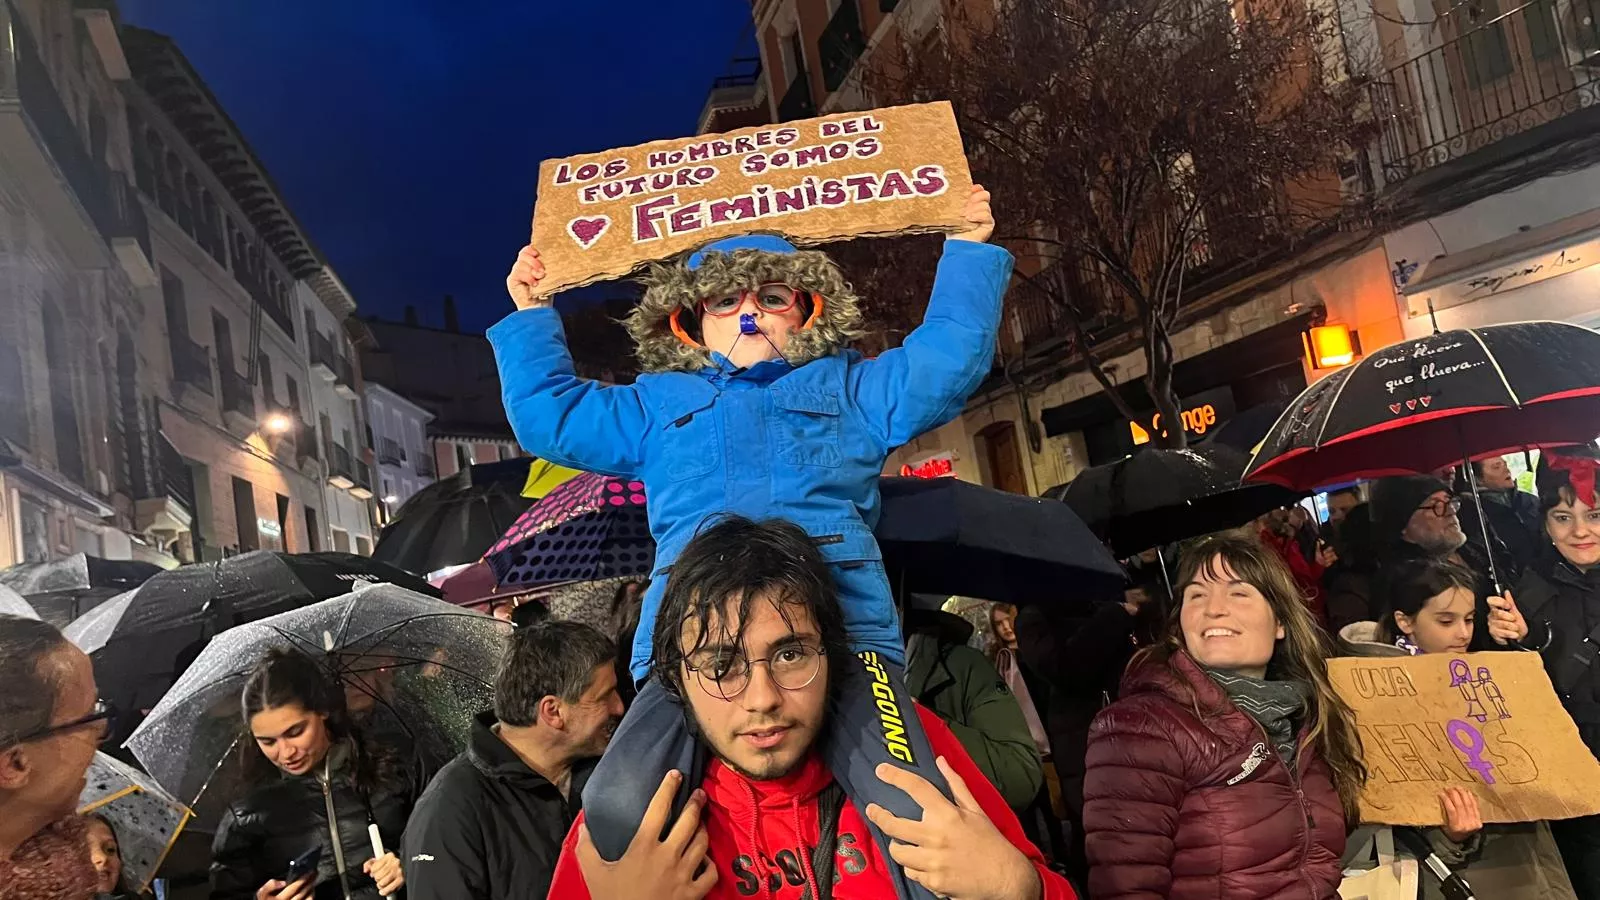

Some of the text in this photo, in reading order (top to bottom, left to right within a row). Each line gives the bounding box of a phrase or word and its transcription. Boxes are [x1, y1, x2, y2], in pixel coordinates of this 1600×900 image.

[554, 116, 882, 185] LOS HOMBRES DEL
[581, 137, 880, 203] FUTURO SOMOS
[1385, 375, 1414, 394] que
[1351, 666, 1417, 699] UNA
